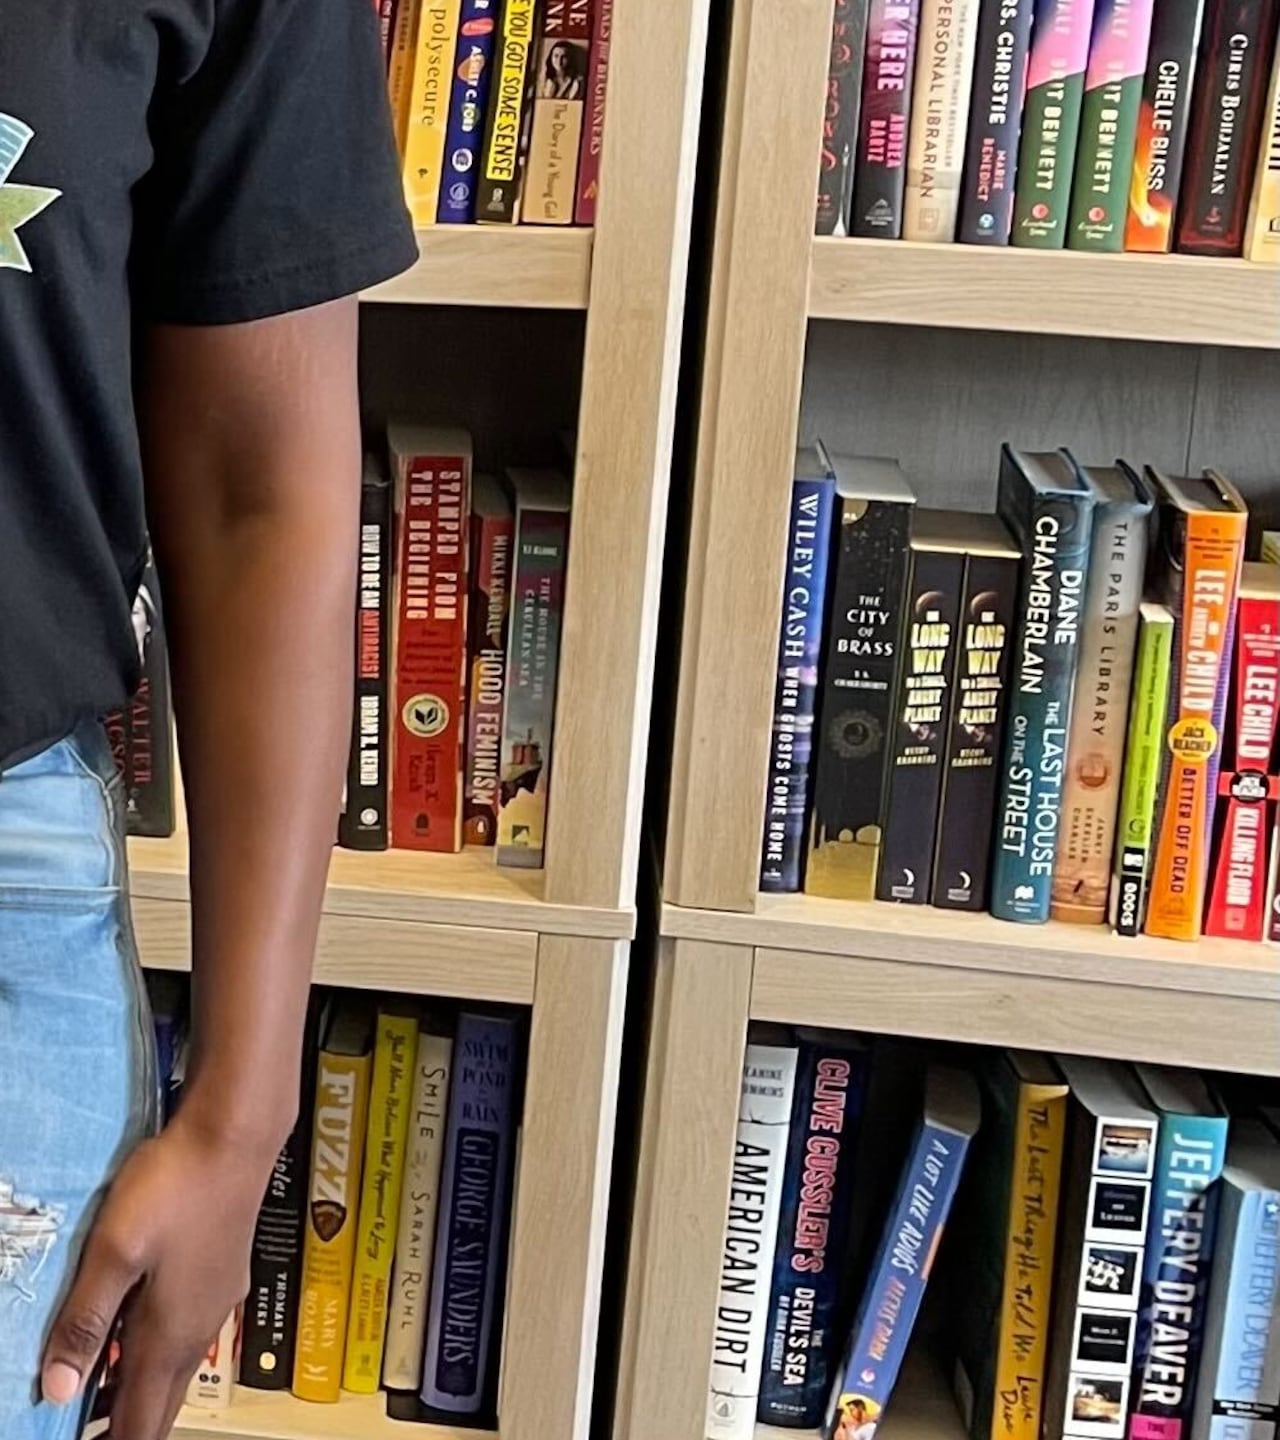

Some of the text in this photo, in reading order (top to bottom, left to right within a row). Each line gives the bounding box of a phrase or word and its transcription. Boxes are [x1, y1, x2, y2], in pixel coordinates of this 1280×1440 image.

[503, 41, 526, 74] GOT
[509, 9, 530, 37] YOU
[877, 30, 909, 91] HERE
[420, 7, 451, 127] polysecure
[498, 76, 522, 120] SOME
[988, 31, 1015, 125] CHRISTIE
[590, 63, 608, 156] BEGINNERS
[1146, 60, 1181, 192] CHELLE BLISS
[491, 122, 516, 178] SENSE
[919, 98, 944, 199] LIBRARIAN
[1035, 106, 1063, 191] BENNETT
[1092, 109, 1119, 194] BENNETT
[409, 470, 434, 506] THE
[435, 470, 462, 555] STAMPED
[405, 520, 432, 620] BEGINNING
[857, 594, 881, 606] THE
[1020, 515, 1060, 694] CHAMBERLAIN
[1053, 569, 1084, 646] DIANE
[1192, 568, 1227, 606] LEE
[836, 639, 894, 657] BRASS
[845, 609, 891, 626] CITY
[857, 626, 875, 638] OF
[910, 622, 950, 649] LONG
[965, 623, 1006, 650] LONG
[1092, 522, 1129, 737] THE PARIS LIBRARY
[471, 578, 506, 806] KENDALL HOOD FEMINISM
[766, 492, 820, 862] WILEY CASH WHEN GHOSTS COME HOME
[912, 649, 946, 674] WAY
[967, 650, 1002, 676] WAY
[1181, 650, 1219, 711] CHILD
[1243, 664, 1278, 703] LEE
[1239, 703, 1274, 758] CHILD
[1002, 715, 1033, 857] ON STREET
[1029, 701, 1066, 876] THE LAST HOUSE
[1170, 767, 1198, 893] BETTER OFF DEAD
[461, 1066, 508, 1087] POND
[461, 1102, 500, 1123] RAIN
[310, 1068, 356, 1207] FUZZ
[791, 1057, 851, 1274] CLIVE CUSSLER'S
[922, 1153, 945, 1187] LOT
[400, 1065, 447, 1331] SMILE SARAH RUHL
[908, 1183, 936, 1227] LIKE
[442, 1135, 493, 1366] GEORGE SAUNDERS
[712, 1140, 772, 1374] AMERICAN DIRT
[1140, 1131, 1215, 1406] JEFFERY DEAVER
[273, 1271, 288, 1328] THOMAS
[782, 1286, 816, 1387] DEVIL'S SEA
